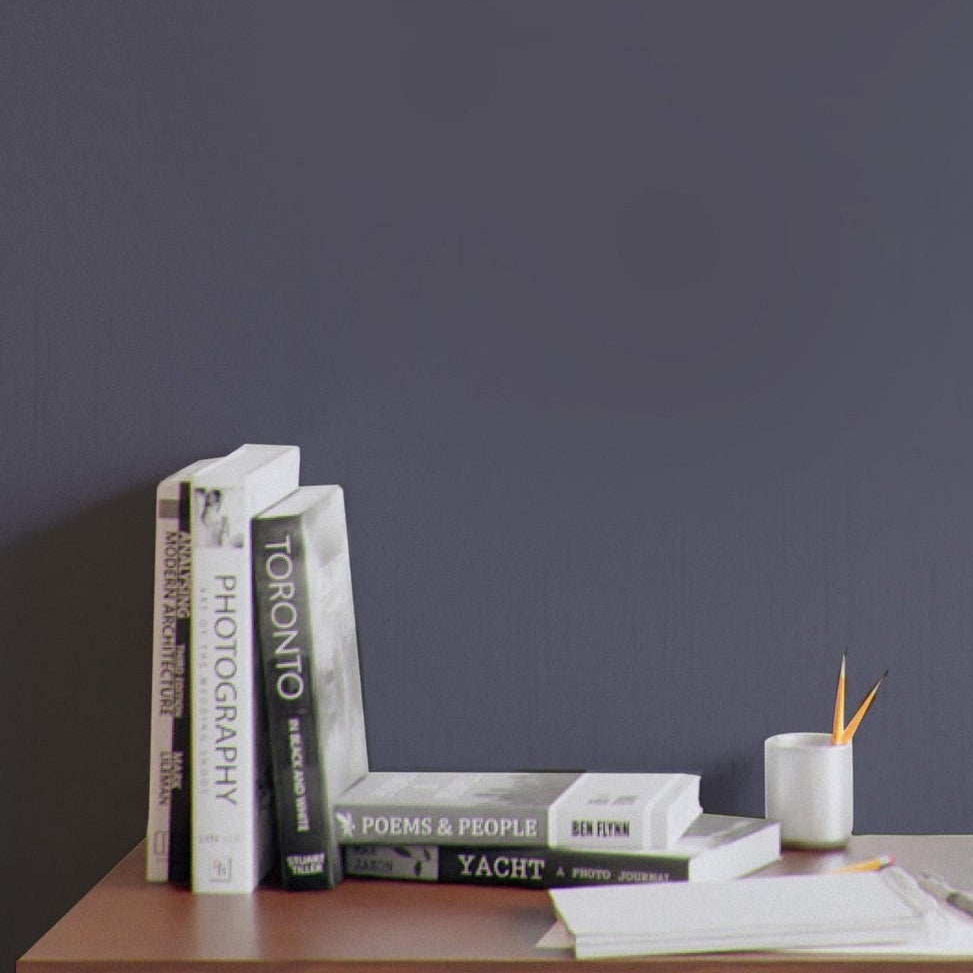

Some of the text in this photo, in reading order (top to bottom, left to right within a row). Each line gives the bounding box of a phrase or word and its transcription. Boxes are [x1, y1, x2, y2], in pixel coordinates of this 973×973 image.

[177, 531, 191, 619] ANALYSING
[160, 531, 177, 716] MODERN ARCHITECTURE
[264, 535, 304, 700] TORONTO
[214, 575, 238, 805] PHOTOGRAPHY
[290, 733, 304, 769] BLACK
[293, 769, 306, 795] AND
[295, 796, 310, 832] WHITE
[362, 815, 538, 837] POEMS & PEOPLE
[571, 819, 630, 838] BEN FLYNN
[457, 854, 545, 879] YACHT
[556, 867, 565, 877] A
[572, 866, 612, 880] PHOTO
